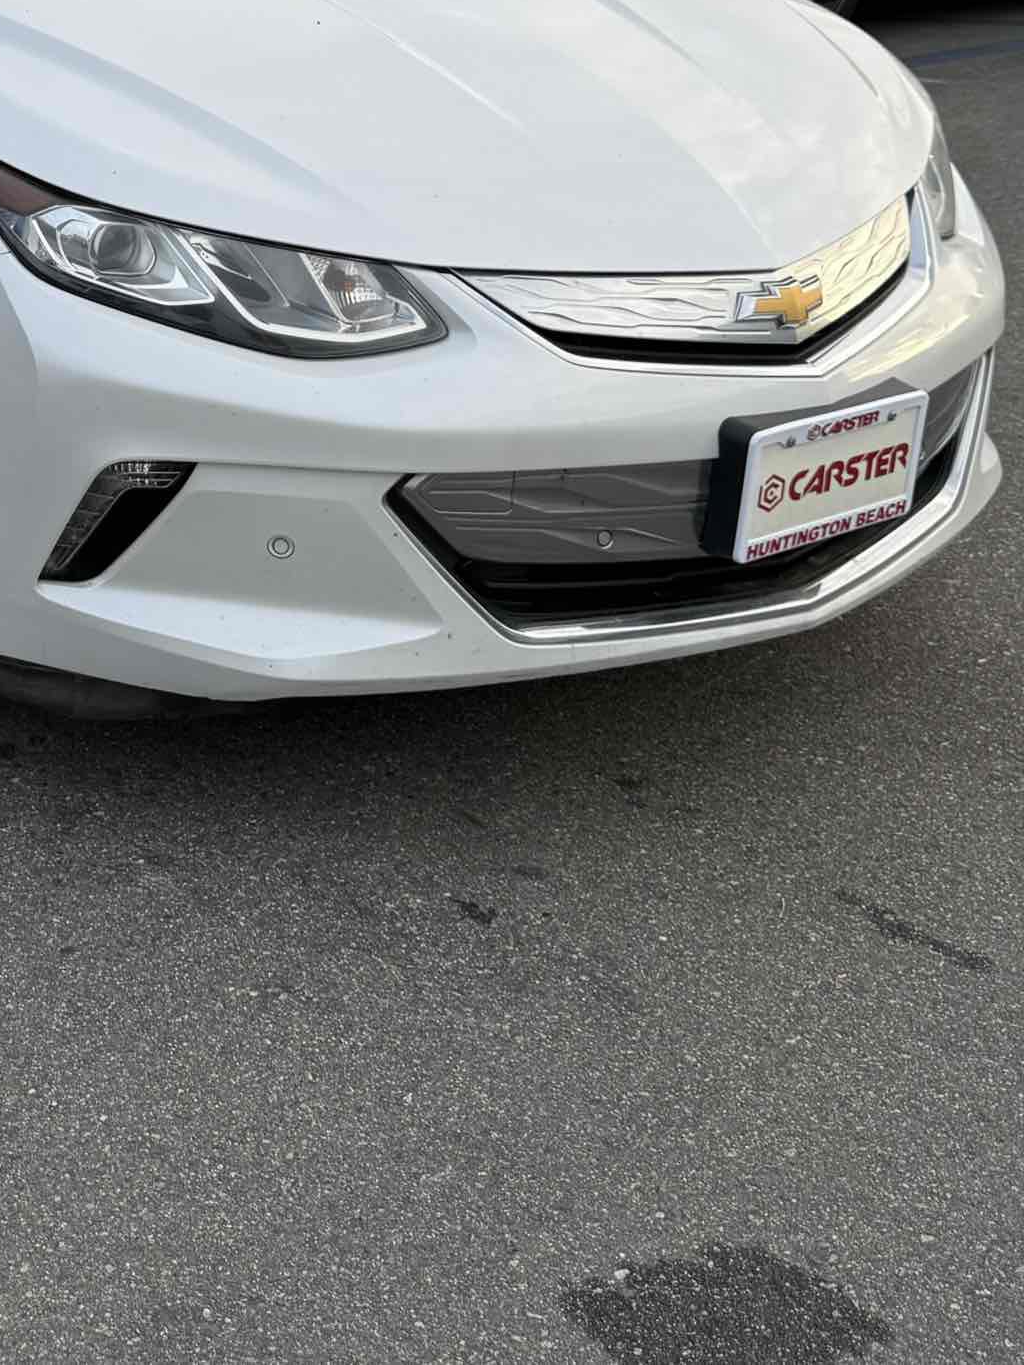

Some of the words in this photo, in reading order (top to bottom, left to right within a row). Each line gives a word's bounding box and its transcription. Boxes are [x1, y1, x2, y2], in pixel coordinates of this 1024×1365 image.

[822, 410, 880, 436] CARSTER
[788, 442, 910, 501] CARSTER
[746, 516, 853, 561] HUNTINGTON
[856, 499, 907, 527] BEACH
